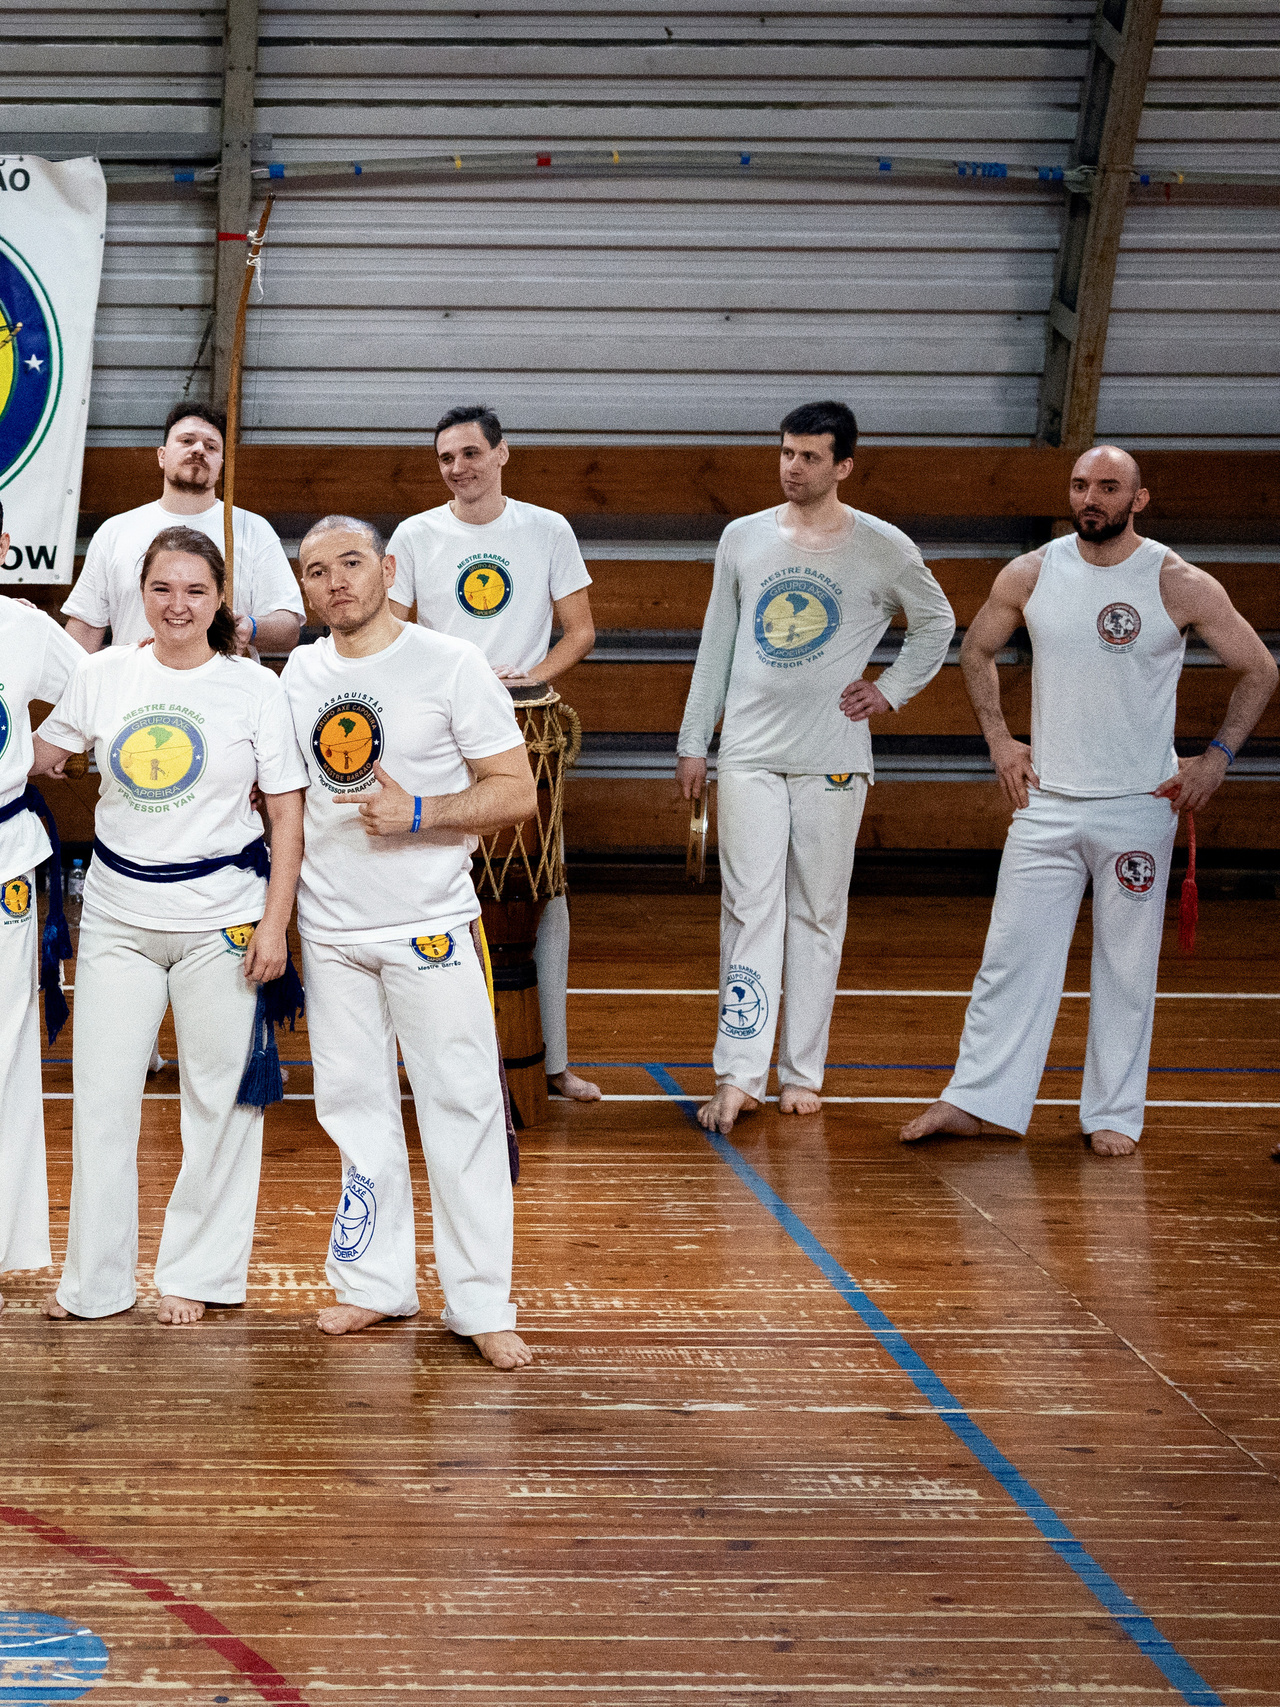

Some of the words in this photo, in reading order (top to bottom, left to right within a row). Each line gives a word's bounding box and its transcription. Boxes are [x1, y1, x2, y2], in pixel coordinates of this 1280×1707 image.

[457, 553, 482, 570] MESTRE
[760, 566, 802, 588] MESTRE
[804, 566, 843, 596] BARRÃO
[769, 581, 807, 597] GRUPO
[755, 649, 803, 669] PROFESSOR
[806, 650, 825, 664] YAN
[318, 692, 384, 714] CASAQUISTÃO
[122, 703, 167, 722] MESTRE
[169, 703, 206, 725] BARRÃO
[131, 716, 171, 731] GRUPO
[316, 710, 336, 732] GRUPO
[352, 704, 378, 731] CAPOEIRA
[322, 762, 344, 781] MESTRE
[173, 792, 196, 809] YAN
